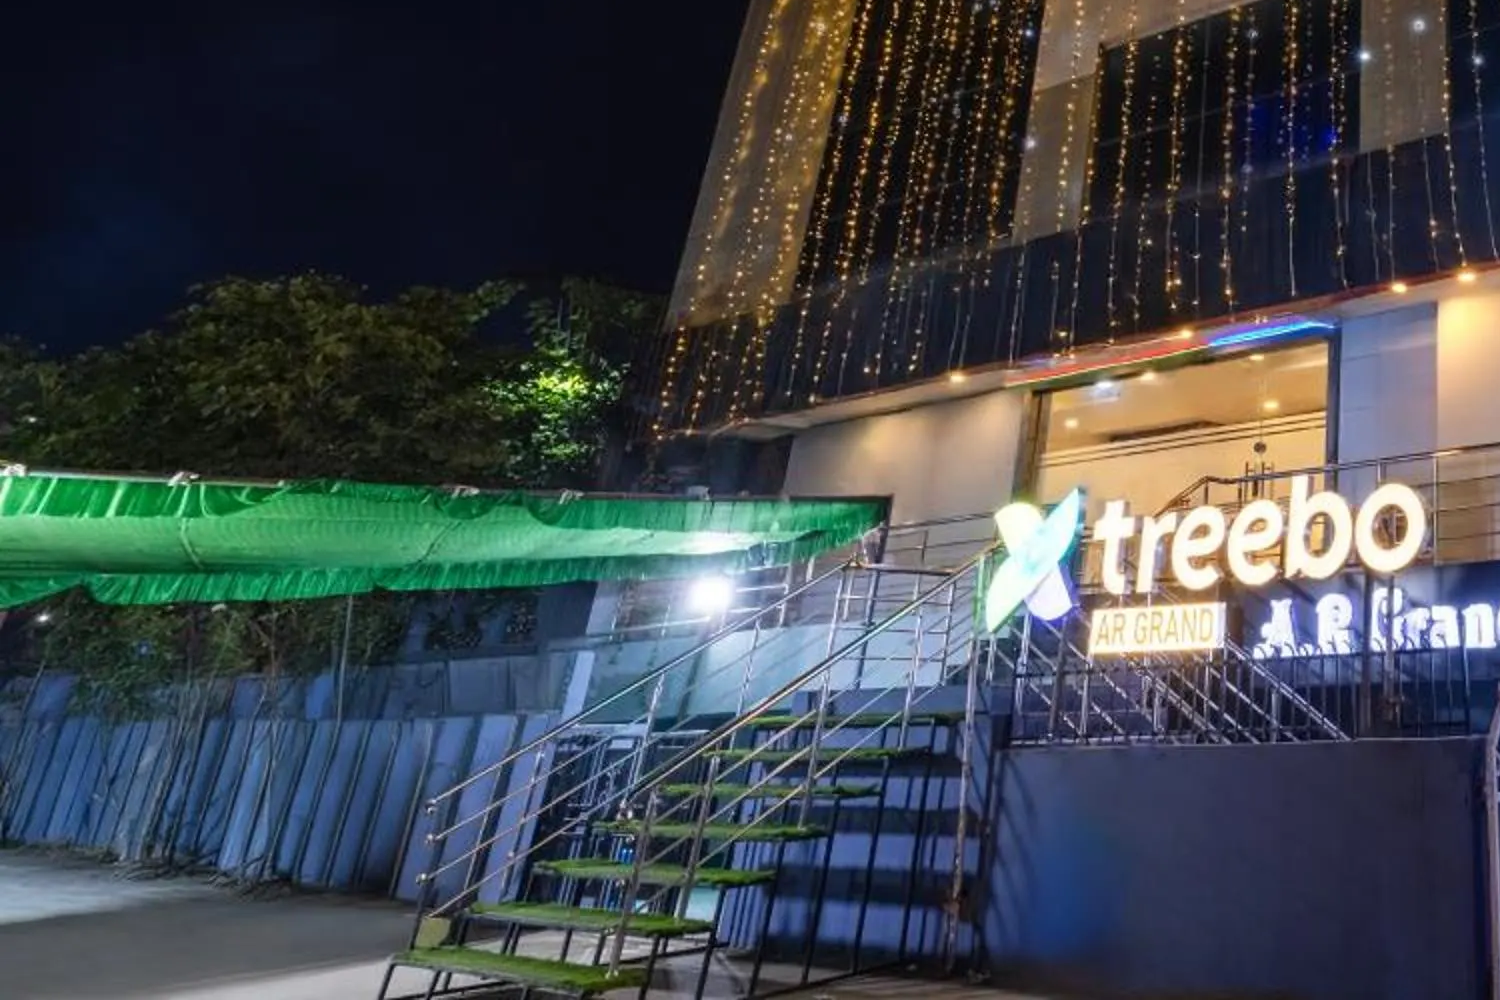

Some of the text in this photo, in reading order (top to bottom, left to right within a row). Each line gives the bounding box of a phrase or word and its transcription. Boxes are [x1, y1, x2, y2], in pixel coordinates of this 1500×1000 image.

[1092, 473, 1427, 595] treebo
[1095, 607, 1214, 647] AR GRAND
